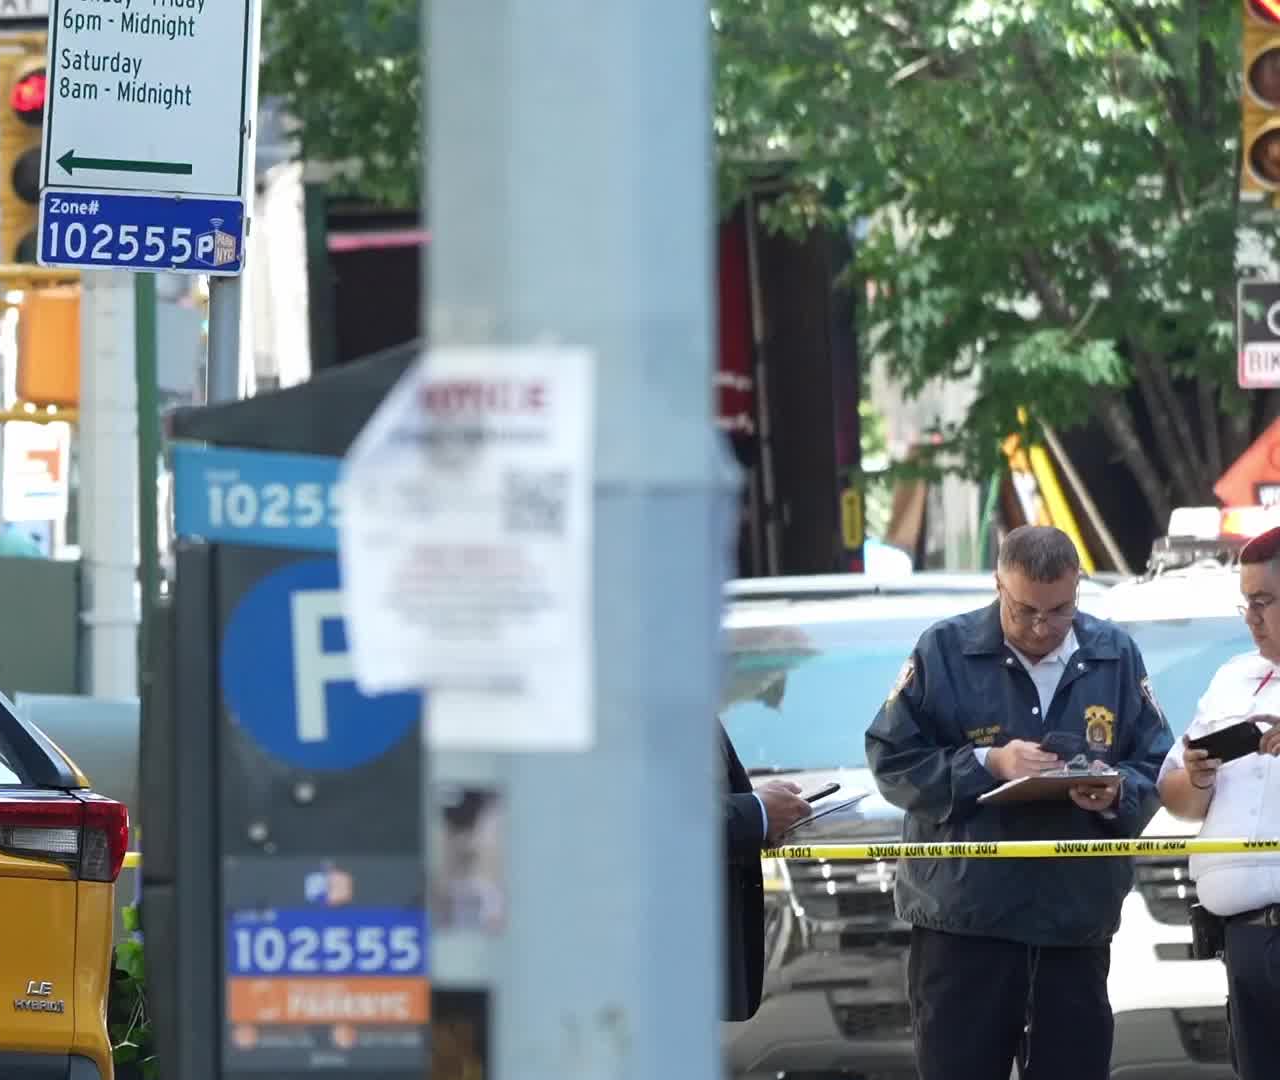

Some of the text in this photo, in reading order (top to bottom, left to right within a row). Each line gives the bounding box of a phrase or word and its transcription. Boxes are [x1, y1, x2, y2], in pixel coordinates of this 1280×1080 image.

[63, 8, 102, 34] 6pm
[121, 12, 196, 41] Midnight
[61, 48, 142, 80] Saturday
[59, 76, 98, 100] 8am
[118, 80, 192, 110] Midnight
[49, 198, 100, 216] Zone#
[49, 221, 192, 264] 102555
[235, 926, 420, 973] 102555
[25, 980, 53, 996] LE
[14, 999, 64, 1013] HYBRID
